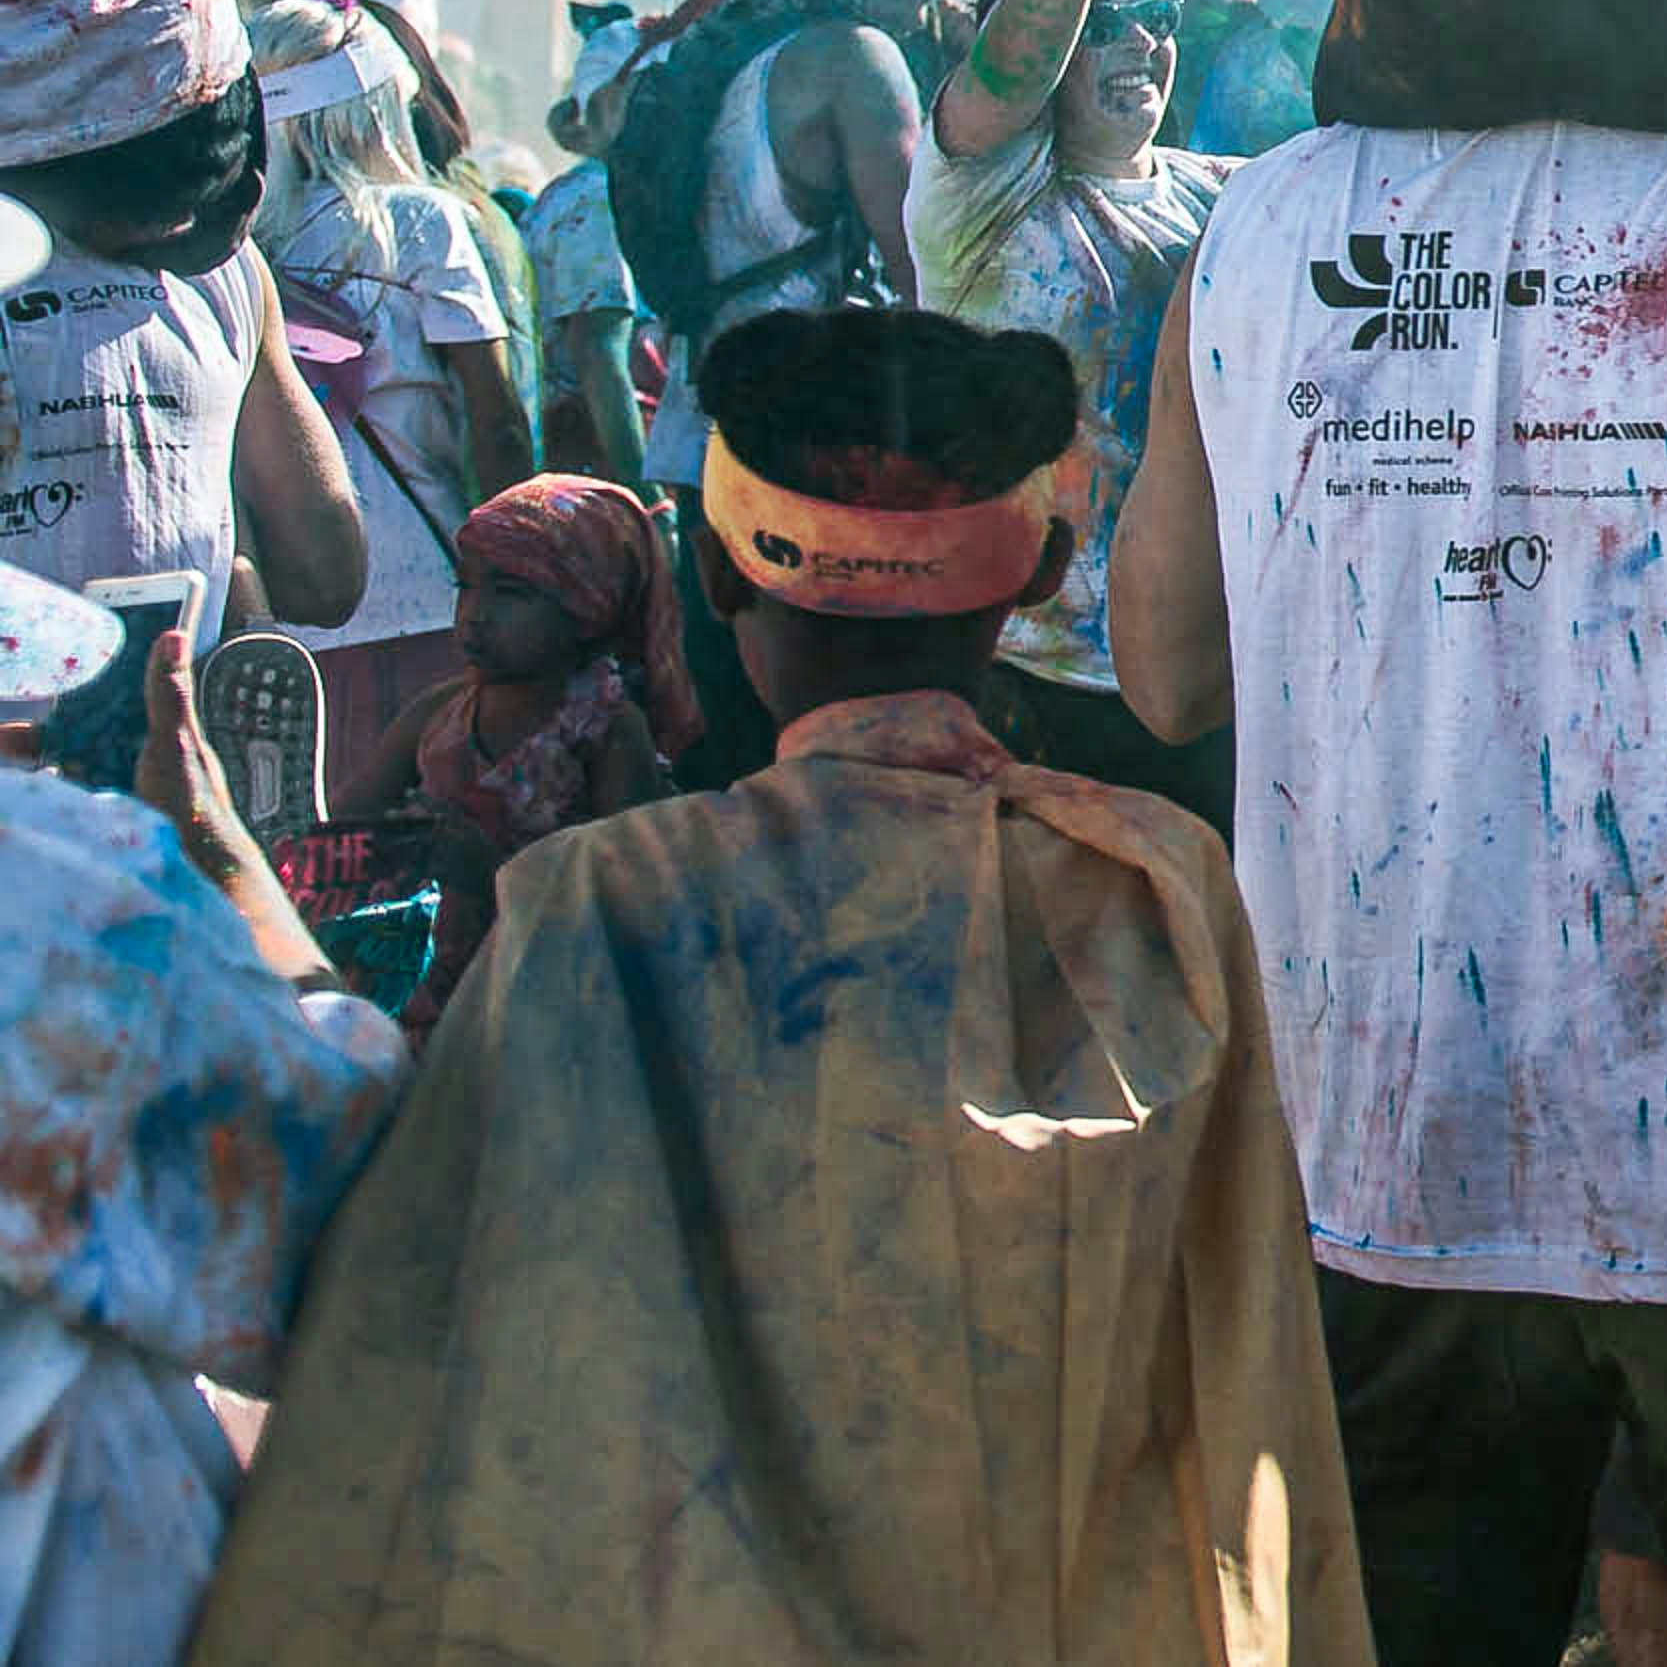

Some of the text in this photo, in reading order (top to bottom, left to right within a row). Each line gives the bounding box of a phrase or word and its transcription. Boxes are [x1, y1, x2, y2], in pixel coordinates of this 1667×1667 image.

[1400, 230, 1454, 271] THE
[1393, 271, 1492, 310] COLOR
[1391, 312, 1459, 351] RUN.
[1322, 408, 1476, 451] medihelp
[1326, 476, 1471, 502] fun fit healthy
